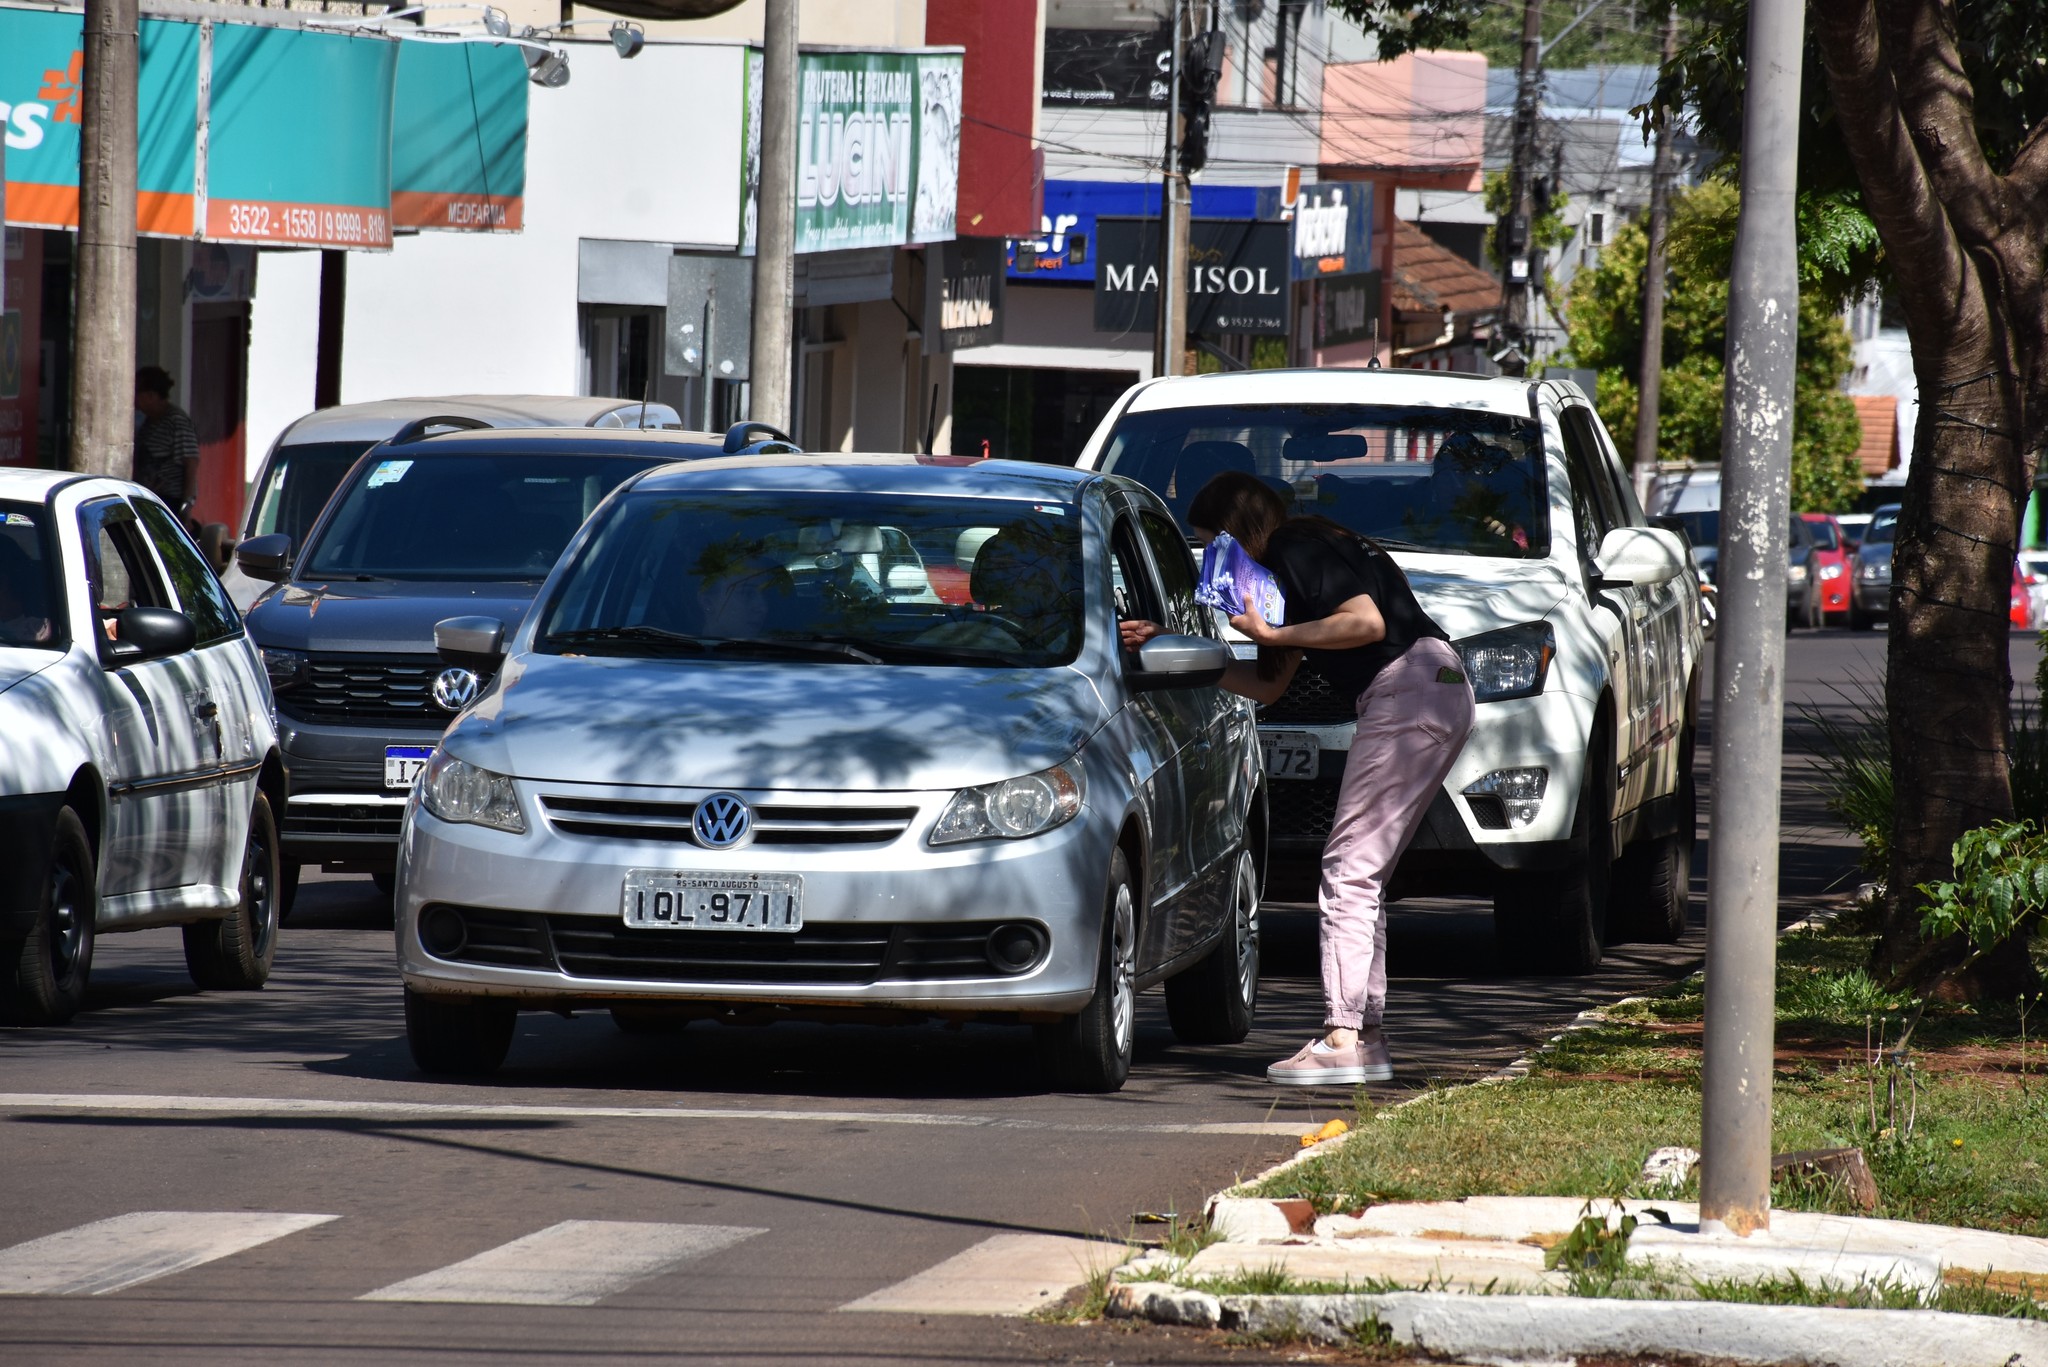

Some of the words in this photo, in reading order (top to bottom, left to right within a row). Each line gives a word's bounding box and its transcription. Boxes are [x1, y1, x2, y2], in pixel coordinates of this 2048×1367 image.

[803, 71, 854, 103] FRUTEIRA
[856, 71, 863, 103] E
[864, 71, 911, 103] PEIXARIA
[229, 204, 270, 235] 3522
[282, 208, 317, 238] 1558
[448, 202, 506, 225] MEDFARMA
[1105, 263, 1280, 295] MAISOL
[1266, 748, 1311, 774] 172
[721, 880, 759, 889] AUGUSTO
